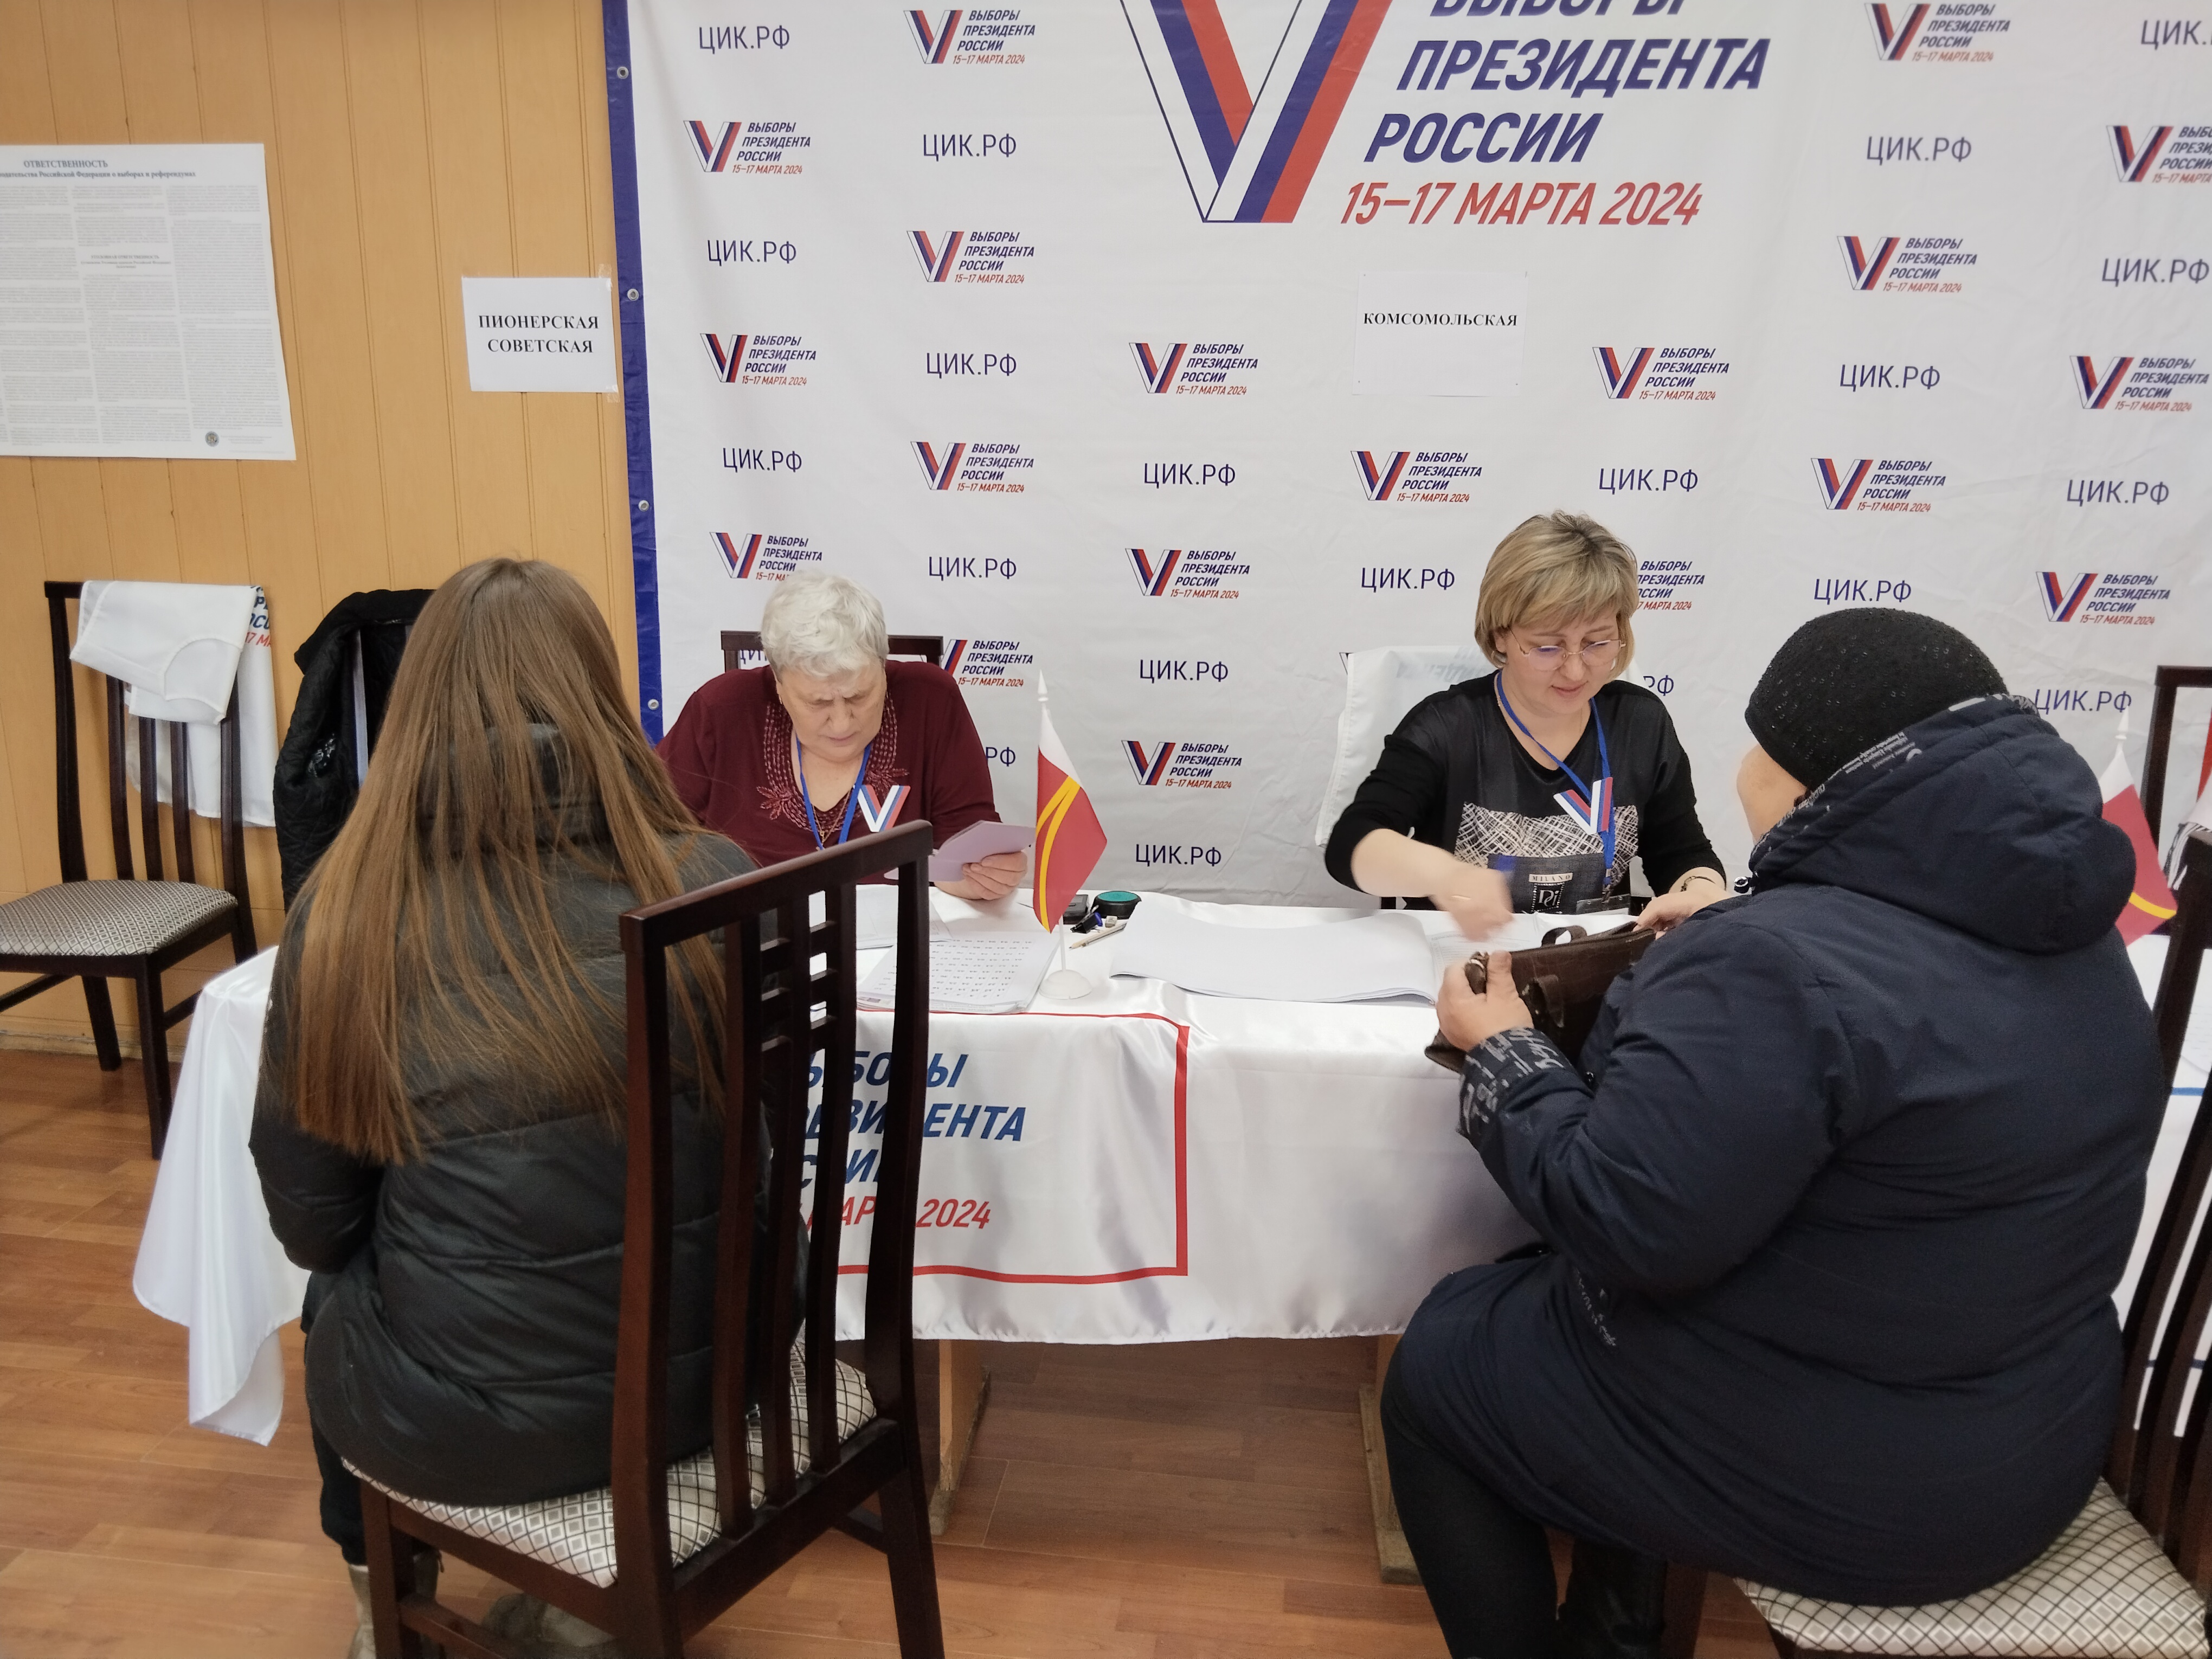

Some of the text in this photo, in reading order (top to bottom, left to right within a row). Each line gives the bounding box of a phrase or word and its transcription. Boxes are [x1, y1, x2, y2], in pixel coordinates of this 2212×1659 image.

[968, 10, 1020, 21] ВЫБОРЫ
[1935, 3, 1996, 16] ВЫБОРЫ
[962, 24, 1036, 37] ПРЕЗИДЕНТА
[1927, 20, 2011, 34] ПРЕЗИДЕНТА
[699, 25, 790, 55] ЦИК.РФ
[2140, 19, 2212, 51] ЦИК.
[957, 40, 1004, 52] РОССИИ
[1919, 36, 1973, 48] РОССИИ
[976, 54, 1004, 64] МАРТА
[1005, 54, 1025, 65] 2024
[1938, 51, 1971, 62] МАРТА
[1970, 51, 1994, 62] 2024
[1397, 38, 1771, 98] ПРЕЗИДЕНТА
[747, 122, 796, 133] ВЫБОРЫ
[742, 137, 811, 149] ПРЕЗИДЕНТА
[1364, 112, 1604, 163] РОССИИ
[923, 133, 1017, 162] ЦИК.РФ
[1867, 136, 1972, 166] ЦИК.РФ
[2168, 142, 2212, 156] ПРЕЗИ
[736, 151, 782, 162] РОССИИ
[23, 160, 108, 168] ОТВЕТСТВЕННОСТЬ
[755, 165, 782, 174] МАРТА
[783, 165, 802, 175] 2024
[1453, 182, 1597, 225] МАРТА
[1598, 182, 1703, 226] 2024
[969, 232, 1020, 242] ВЫБОРЫ
[1905, 237, 1963, 249] ВЫБОРЫ
[707, 240, 796, 267] ЦИК.РФ
[964, 246, 1034, 259] ПРЕЗИДЕНТА
[958, 260, 1004, 271] РОССИИ
[1896, 253, 1977, 266] ПРЕЗИДЕНТА
[1889, 267, 1941, 279] РОССИИ
[2101, 258, 2210, 287] ЦИК.РФ
[976, 274, 1004, 284] МАРТА
[1005, 274, 1025, 284] 2024
[1907, 282, 1939, 292] МАРТА
[1939, 283, 1962, 293] 2024
[478, 315, 599, 329] ПИОНЕРСКАЯ
[1363, 313, 1518, 327] КОМСОМОЛЬСКАЯ
[487, 339, 594, 353] СОВЕТСКАЯ
[753, 335, 802, 346] ВЫБОРЫ
[748, 349, 816, 361] ПРЕЗИДЕНТА
[1193, 344, 1244, 355] ВЫБОРЫ
[1660, 348, 1716, 359] ВЫБОРЫ
[744, 362, 787, 374] РОССИИ
[927, 352, 1017, 379] ЦИК.РФ
[1186, 358, 1258, 370] ПРЕЗИДЕНТА
[1652, 362, 1729, 375] ПРЕЗИДЕНТА
[2138, 357, 2196, 369] ВЫБОРЫ
[761, 376, 787, 385] МАРТА
[788, 376, 807, 386] 2024
[1180, 372, 1227, 383] РОССИИ
[1644, 376, 1696, 387] РОССИИ
[1840, 364, 1940, 393] ЦИК.РФ
[2130, 372, 2210, 385] ПРЕЗИДЕНТА
[1198, 385, 1226, 395] МАРТА
[1227, 385, 1247, 395] 2024
[1663, 390, 1694, 400] МАРТА
[1694, 391, 1716, 401] 2024
[2121, 387, 2172, 398] РОССИИ
[2139, 401, 2170, 411] МАРТА
[2170, 402, 2192, 412] 2024
[971, 443, 1020, 454] ВЫБОРЫ
[723, 447, 802, 473] ЦИК.РФ
[966, 456, 1034, 469] ПРЕЗИДЕНТА
[1415, 452, 1469, 463] ВЫБОРЫ
[1877, 460, 1933, 471] ВЫБОРЫ
[960, 470, 1005, 481] РОССИИ
[1144, 463, 1236, 489] ЦИК.РФ
[1408, 466, 1482, 478] ПРЕЗИДЕНТА
[1401, 479, 1450, 490] РОССИИ
[1599, 468, 1698, 495] ЦИК.РФ
[1870, 474, 1946, 487] ПРЕЗИДЕНТА
[978, 483, 1005, 492] МАРТА
[1005, 484, 1025, 493] 2024
[1862, 488, 1911, 499] РОССИИ
[2067, 479, 2169, 507] ЦИК.РФ
[1419, 493, 1449, 502] МАРТА
[1449, 493, 1470, 503] 2024
[1880, 502, 1909, 512] МАРТА
[1909, 503, 1931, 512] 2024
[767, 535, 809, 548] ВЫБОРЫ
[763, 548, 822, 561] ПРЕЗИДЕНТА
[1186, 550, 1236, 561] ВЫБОРЫ
[758, 560, 796, 572] РОССИИ
[929, 556, 1017, 581] ЦИК.РФ
[1180, 563, 1250, 575] ПРЕЗИДЕНТА
[1640, 561, 1693, 571] ВЫБОРЫ
[1174, 576, 1220, 587] РОССИИ
[1361, 567, 1455, 593] ЦИК.РФ
[2102, 574, 2158, 586] ВЫБОРЫ
[1192, 589, 1219, 599] МАРТА
[1219, 590, 1239, 599] 2024
[1637, 588, 1674, 599] ОССИИ
[1814, 578, 1912, 606] ЦИК.РФ
[2094, 587, 2171, 601] ПРЕЗИДЕНТА
[1643, 601, 1672, 610] МАРТА
[1671, 601, 1692, 610] 2024
[2086, 601, 2137, 613] РОССИИ
[2103, 615, 2134, 625] МАРТА
[2133, 616, 2155, 625] 2024
[972, 640, 1020, 651] ВЫБОРЫ
[967, 653, 1033, 665] ПРЕЗИДЕНТА
[962, 665, 1005, 676] РОССИИ
[1140, 659, 1229, 684] ЦИК.РФ
[979, 678, 1005, 686] МАРТА
[1005, 678, 1024, 687] 2024
[2035, 689, 2132, 715] ЦИК.РФ
[1181, 743, 1229, 754] ВЫБОРЫ
[1175, 755, 1242, 767] ПРЕЗИДЕНТА
[1169, 767, 1213, 777] РОССИИ
[1186, 779, 1213, 788] МАРТА
[1213, 781, 1232, 789] 2024
[1136, 844, 1221, 867] ЦИК.РФ
[916, 1199, 992, 1229] 2024
